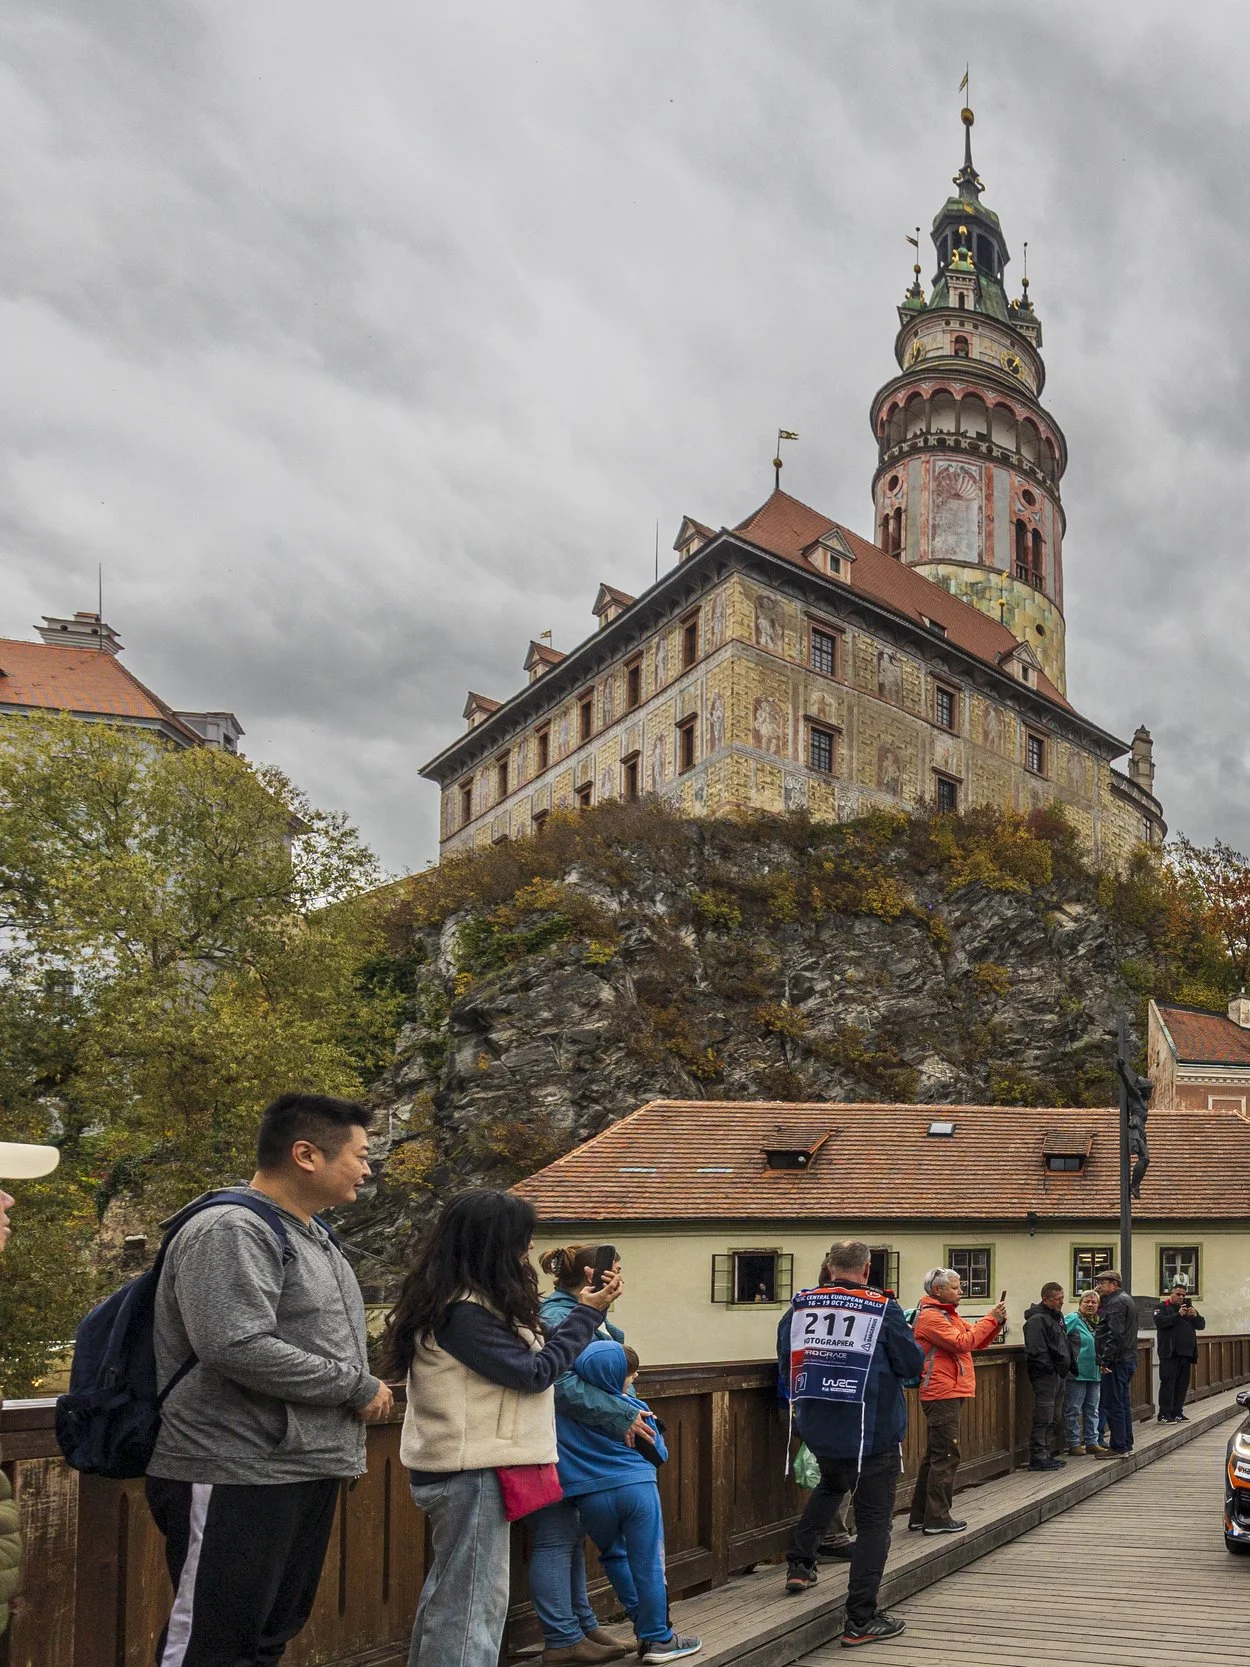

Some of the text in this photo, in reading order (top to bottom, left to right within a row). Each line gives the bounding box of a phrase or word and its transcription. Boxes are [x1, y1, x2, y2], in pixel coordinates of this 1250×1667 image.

[831, 1293, 863, 1303] EUROPEAN
[845, 1301, 863, 1309] 2025
[805, 1312, 856, 1337] 211
[822, 1378, 858, 1389] WRC
